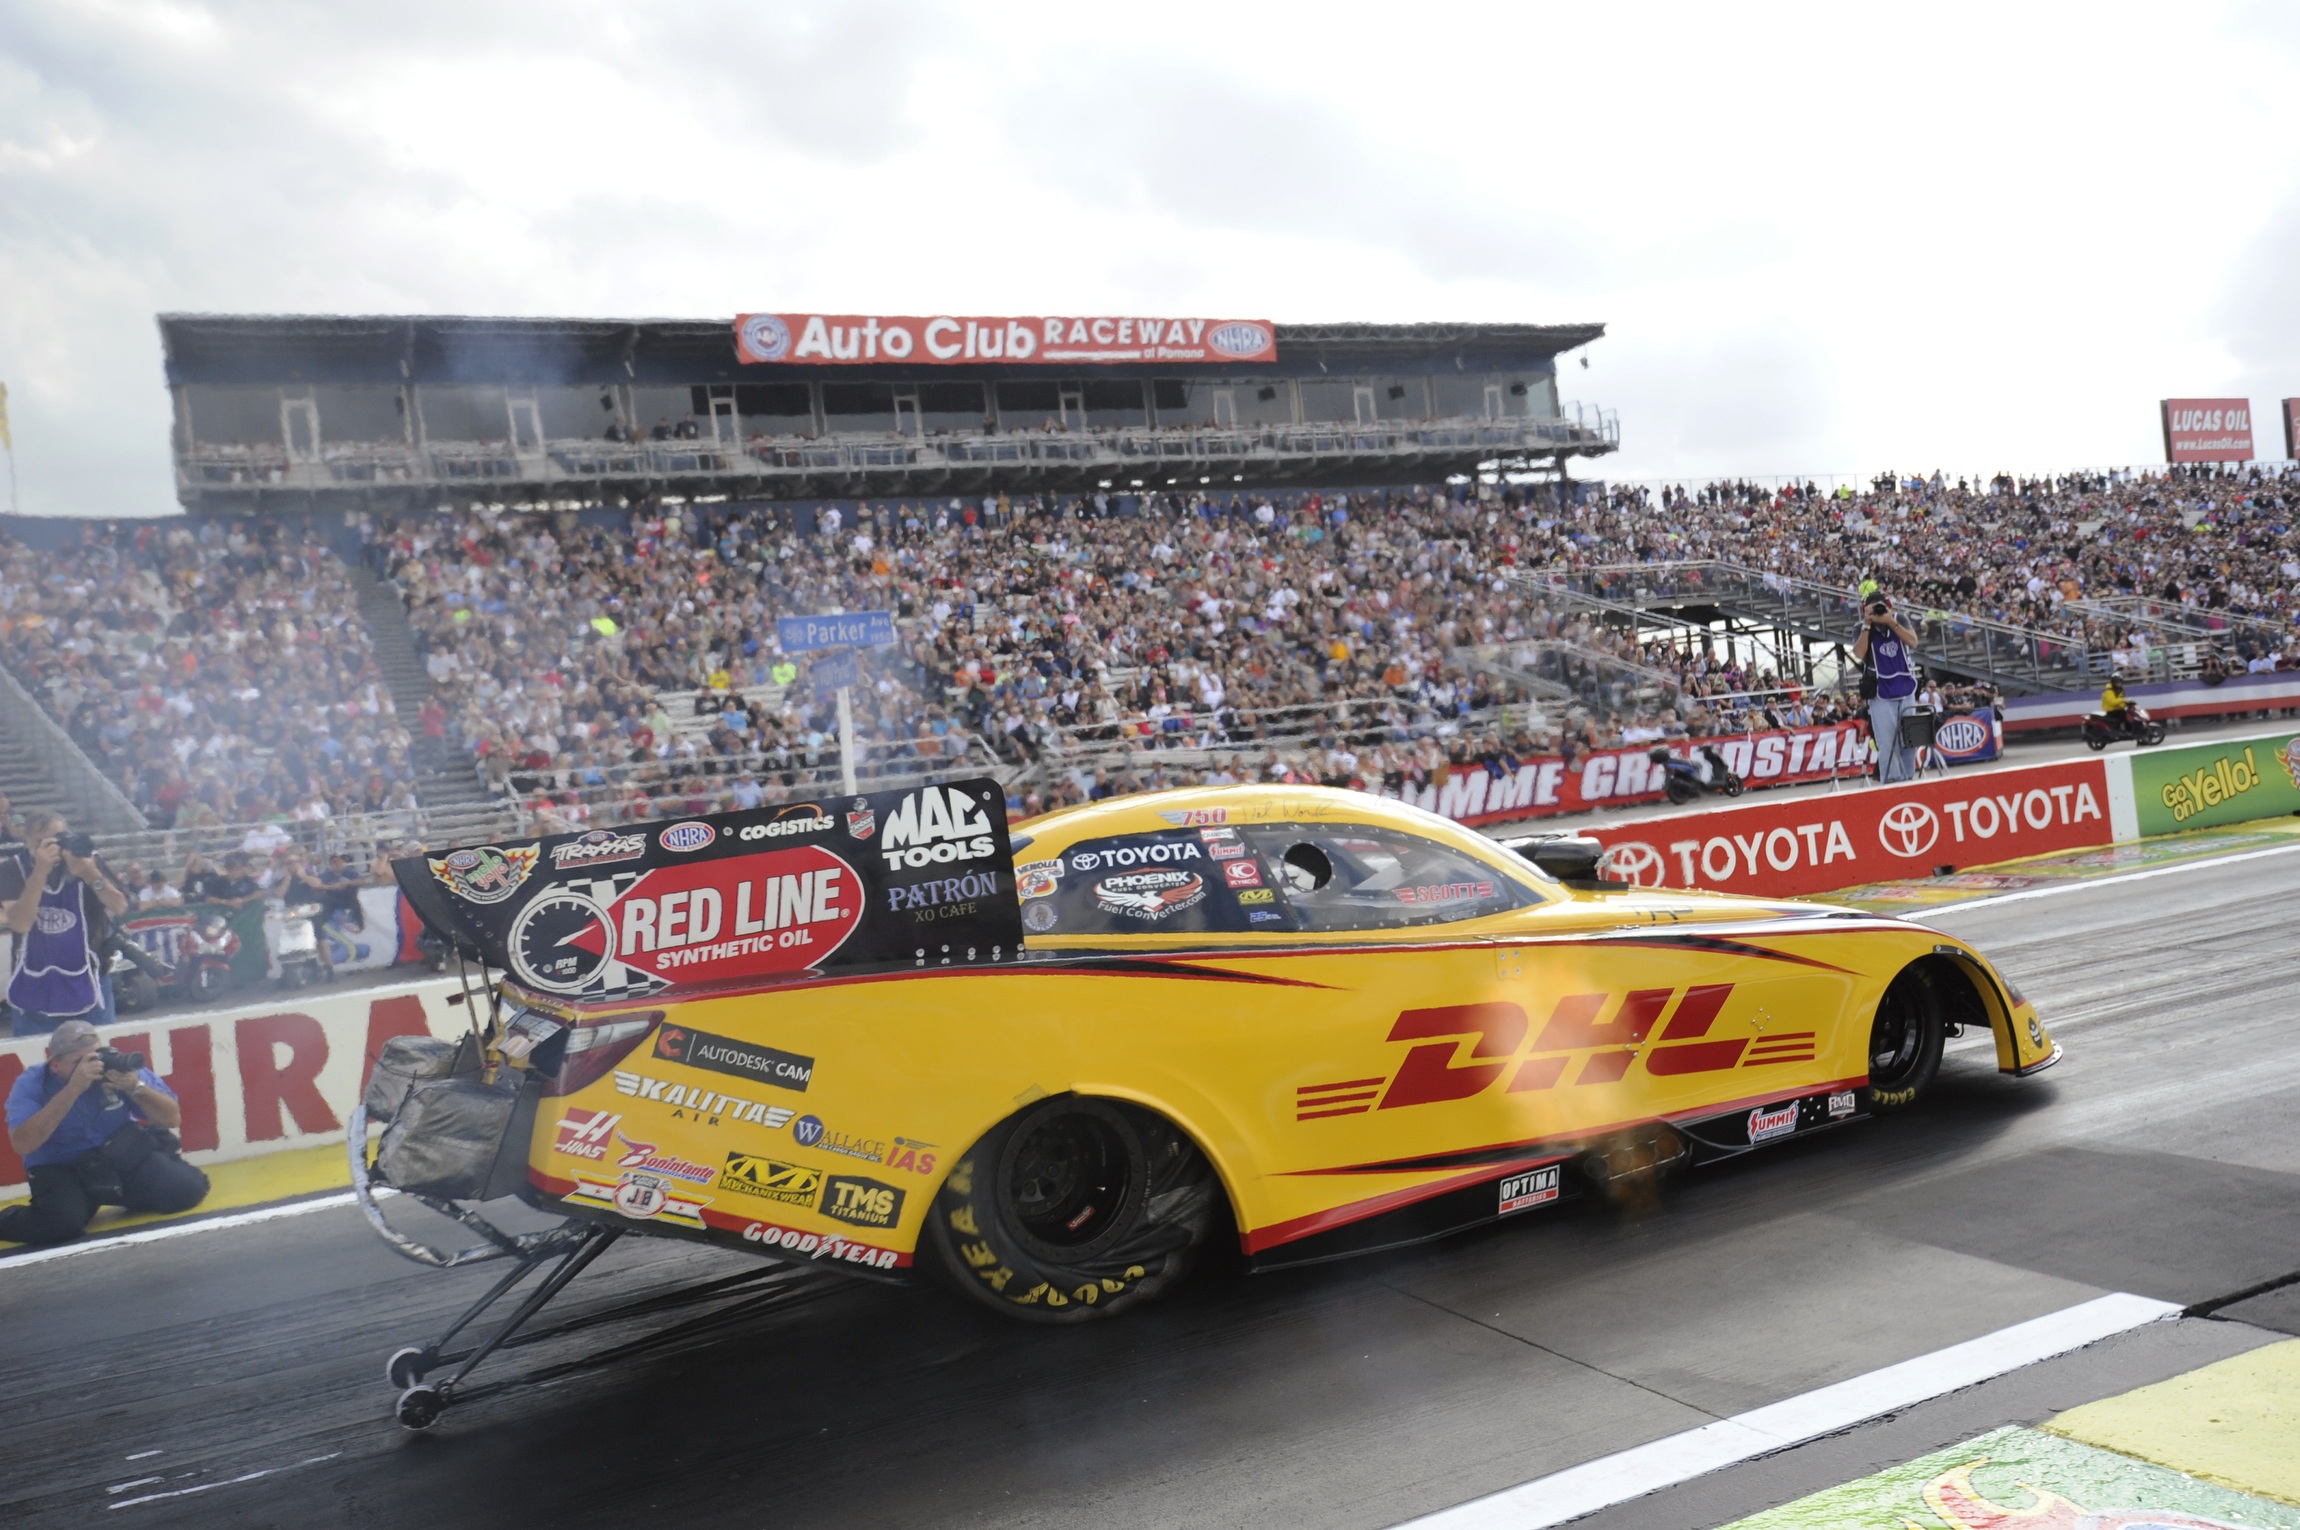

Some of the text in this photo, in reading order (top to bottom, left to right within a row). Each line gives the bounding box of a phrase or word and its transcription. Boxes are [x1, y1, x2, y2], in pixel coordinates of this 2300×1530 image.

[795, 316, 913, 360] Auto
[924, 317, 1037, 360] Club
[1043, 318, 1206, 345] RACEWAY
[1213, 326, 1266, 352] NHRA
[1158, 347, 1204, 359] Pomona
[2172, 409, 2249, 432] LUCAS OIL
[807, 621, 866, 644] Parker
[1941, 722, 1981, 749] NHRA
[2180, 746, 2260, 812] Yello!
[2162, 784, 2188, 808] Go
[881, 786, 992, 850] MAC
[1182, 807, 1228, 827] 750
[1944, 783, 2102, 843] TOYOTA
[2174, 799, 2197, 822] on
[670, 828, 707, 847] NHRA
[739, 815, 835, 841] COGISTICS
[552, 834, 647, 860] TRAXXAS
[882, 836, 995, 871] TOOLS
[1100, 843, 1201, 867] TOYOTA
[1671, 821, 1856, 885] TOYOTA
[451, 854, 478, 867] NHRA
[466, 849, 503, 884] mello
[1017, 860, 1058, 874] VENOLIA
[476, 863, 509, 890] yello
[1105, 871, 1190, 889] PHOENIX
[1230, 878, 1259, 886] KYMCO
[888, 869, 997, 912] PATRÓN
[1417, 882, 1475, 903] SCOTT
[621, 867, 842, 956] RED LINE
[914, 902, 977, 923] XO CAFE
[1098, 890, 1207, 921] Fuel Converter.com
[656, 929, 813, 970] SYNTHETIC OIL
[555, 956, 578, 970] RPM
[1377, 983, 1751, 1110] DHL
[697, 1045, 812, 1082] AUTODESK CAM
[638, 1077, 768, 1124] KALITTA
[1871, 1087, 1916, 1106] EAGLE
[671, 1109, 720, 1126] AIR
[1750, 1105, 1798, 1139] SUMMIT
[797, 1120, 886, 1157] WALLACE
[885, 1146, 937, 1175] IAS
[1502, 1170, 1556, 1200] OPTIMA
[779, 1191, 814, 1208] WEAR
[834, 1181, 894, 1216] TMS
[830, 1204, 889, 1225] TITANIUM
[743, 1222, 899, 1269] GOODYEAR
